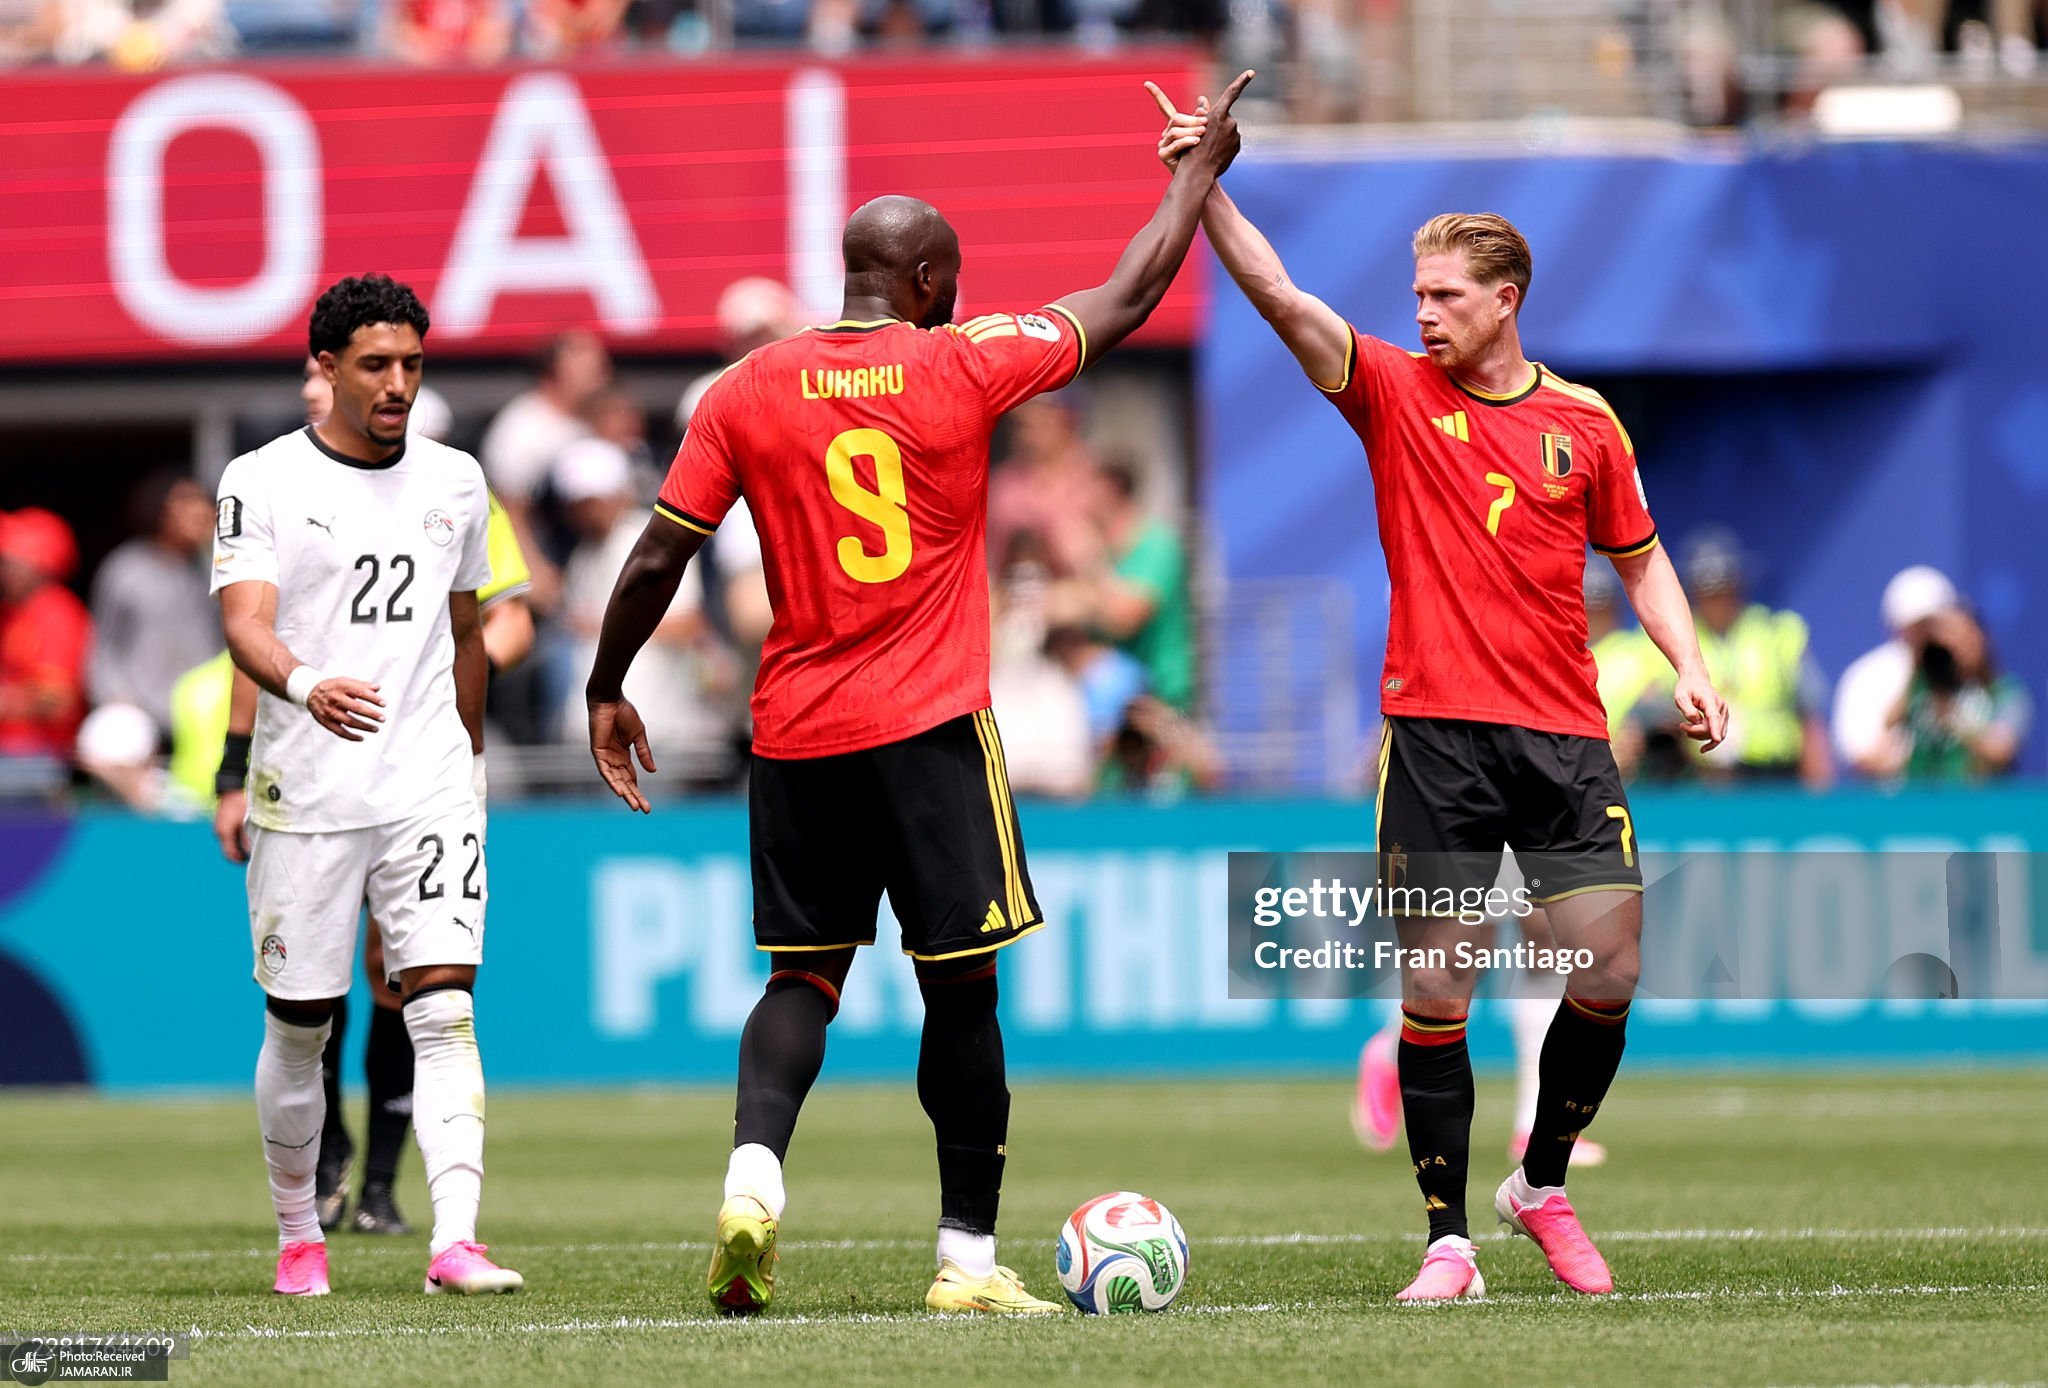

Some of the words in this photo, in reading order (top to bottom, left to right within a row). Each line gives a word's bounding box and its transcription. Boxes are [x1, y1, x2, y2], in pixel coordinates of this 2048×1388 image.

[800, 364, 904, 399] LUKAKU
[825, 428, 913, 583] 9
[1486, 472, 1516, 537] 7
[350, 554, 415, 624] 22
[417, 832, 482, 901] 22
[1606, 805, 1634, 868] 7
